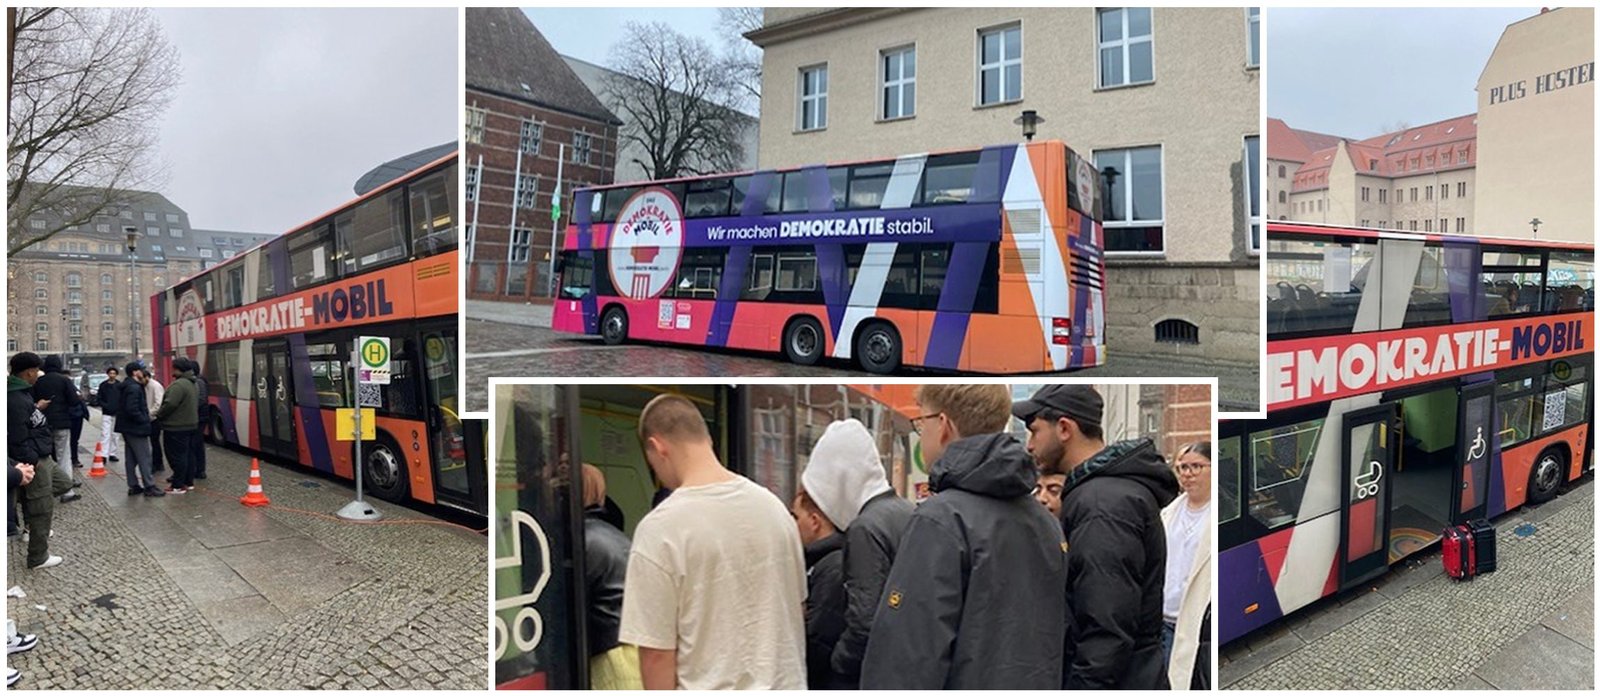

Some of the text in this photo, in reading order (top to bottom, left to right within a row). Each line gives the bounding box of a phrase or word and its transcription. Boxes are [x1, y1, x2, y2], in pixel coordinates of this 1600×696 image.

[1489, 80, 1526, 105] PLUS
[623, 205, 673, 236] DEMOKRATIE
[707, 217, 934, 240] Wir machen DEMOKRATIE stabil.
[369, 344, 381, 361] H
